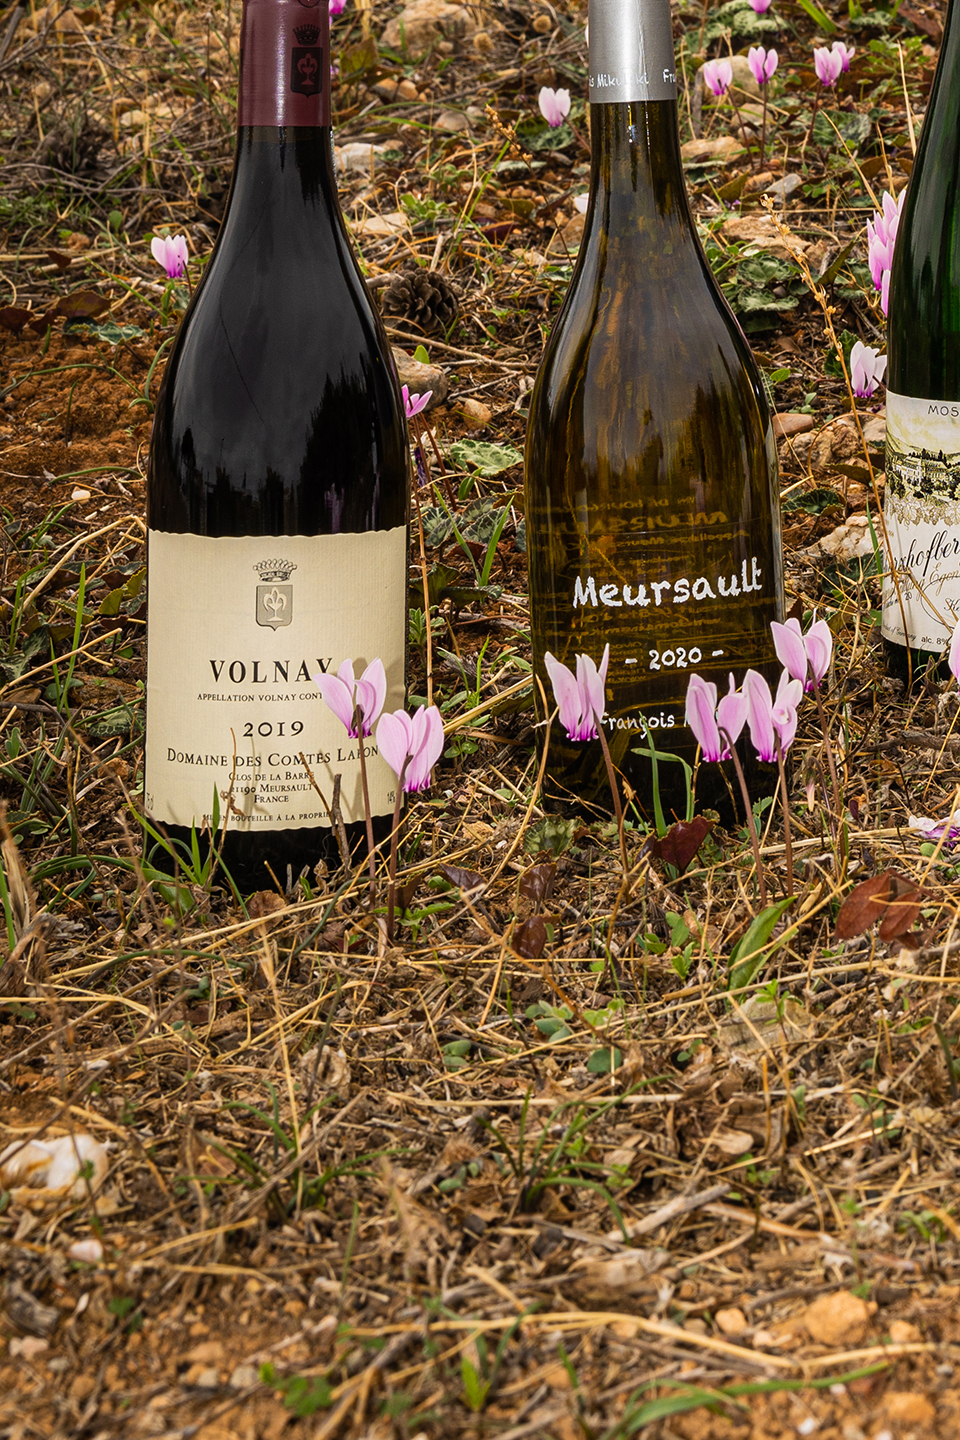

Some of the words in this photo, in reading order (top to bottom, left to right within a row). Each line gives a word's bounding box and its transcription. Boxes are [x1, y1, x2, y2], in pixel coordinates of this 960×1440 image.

[572, 556, 763, 609] Meursault
[929, 562, 960, 596] Egon
[921, 636, 934, 645] alc.
[649, 647, 702, 671] 2020
[209, 657, 333, 684] VOLNAY
[197, 693, 255, 702] APPELLATION
[258, 693, 297, 702] VOLNAY
[242, 720, 304, 738] 2019
[167, 747, 229, 767] DOMAINE
[235, 756, 262, 767] DES
[267, 752, 331, 767] COMTES
[228, 771, 252, 781] CLOS
[254, 773, 267, 781] DE
[269, 773, 282, 781] LA
[259, 783, 313, 793] MEURSAULT
[253, 794, 290, 804] FRANCE
[230, 814, 274, 822] BOUTEILLE
[285, 813, 296, 821] LA
